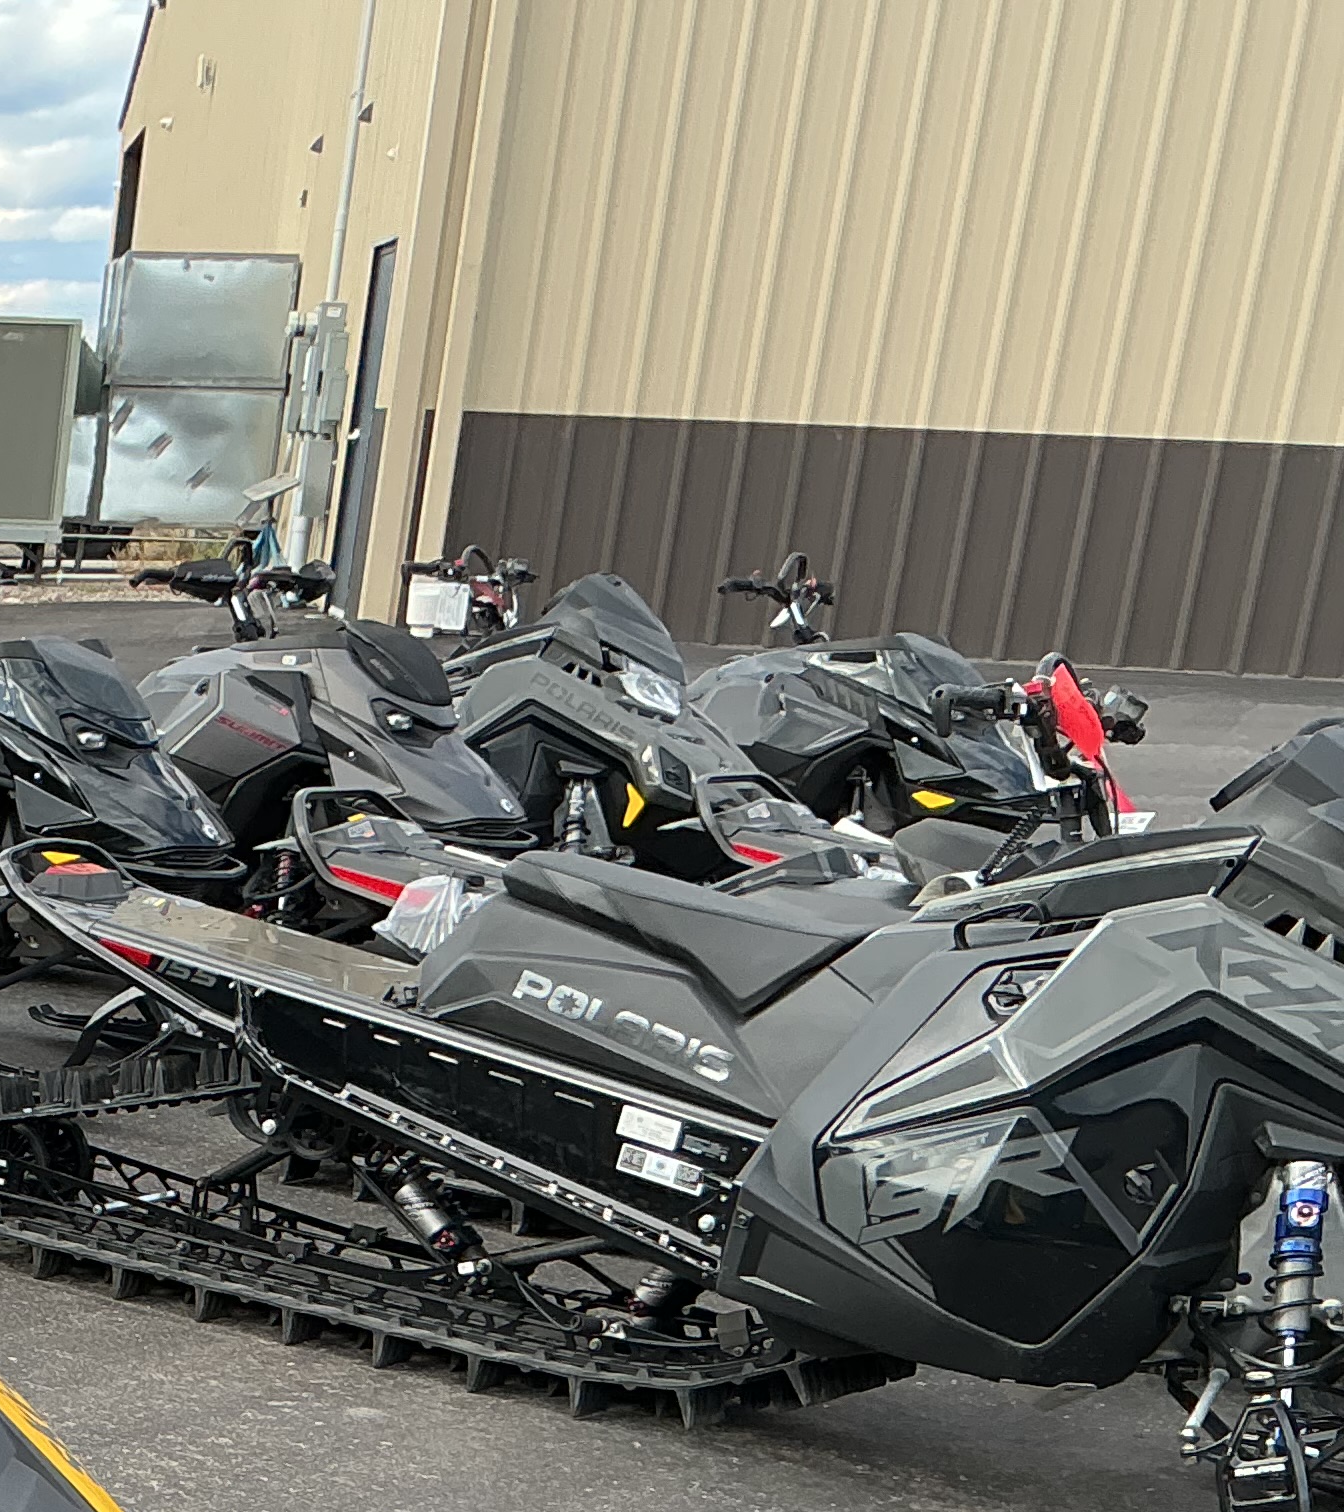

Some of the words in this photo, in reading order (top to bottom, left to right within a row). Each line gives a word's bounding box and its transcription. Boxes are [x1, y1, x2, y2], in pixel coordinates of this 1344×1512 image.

[530, 672, 638, 741] POLARIS
[155, 957, 216, 988] 155
[512, 969, 735, 1083] POLARIS
